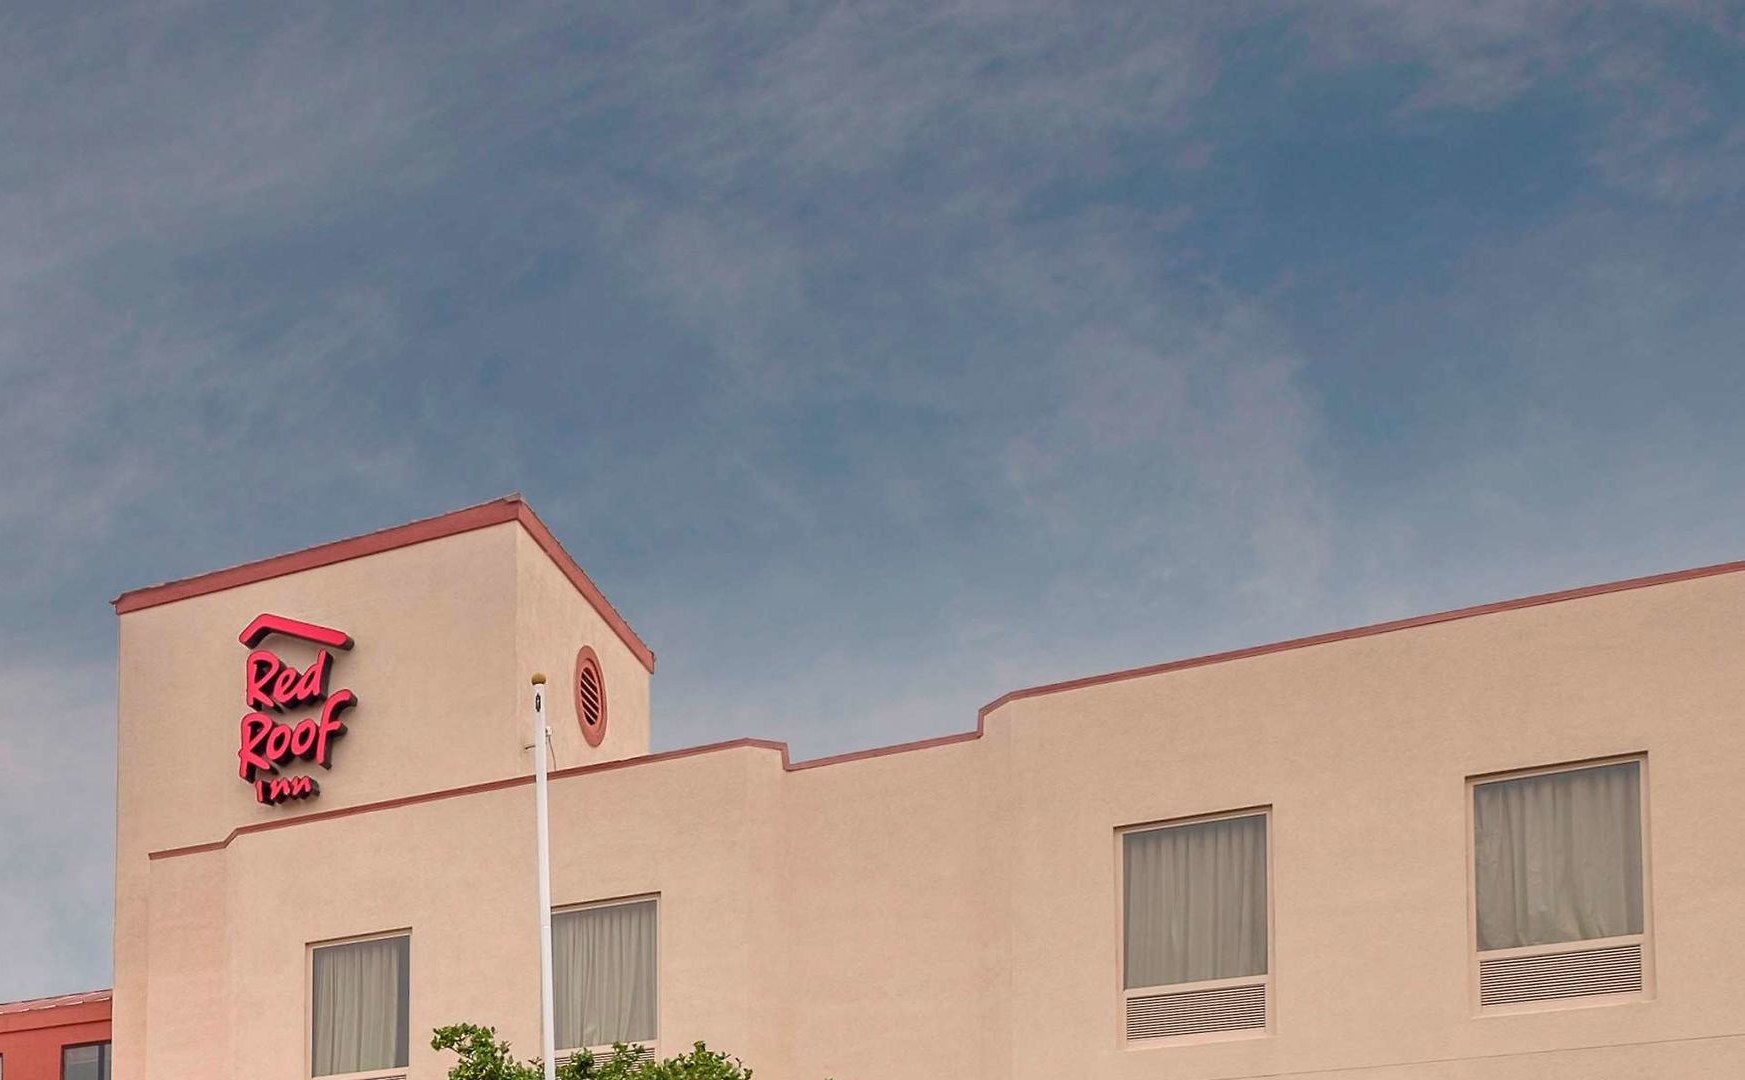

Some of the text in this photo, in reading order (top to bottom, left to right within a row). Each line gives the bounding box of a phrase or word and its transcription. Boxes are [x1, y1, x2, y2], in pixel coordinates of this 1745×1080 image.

[246, 649, 331, 710] Red
[239, 689, 356, 780] Roof
[256, 775, 317, 804] Inn
